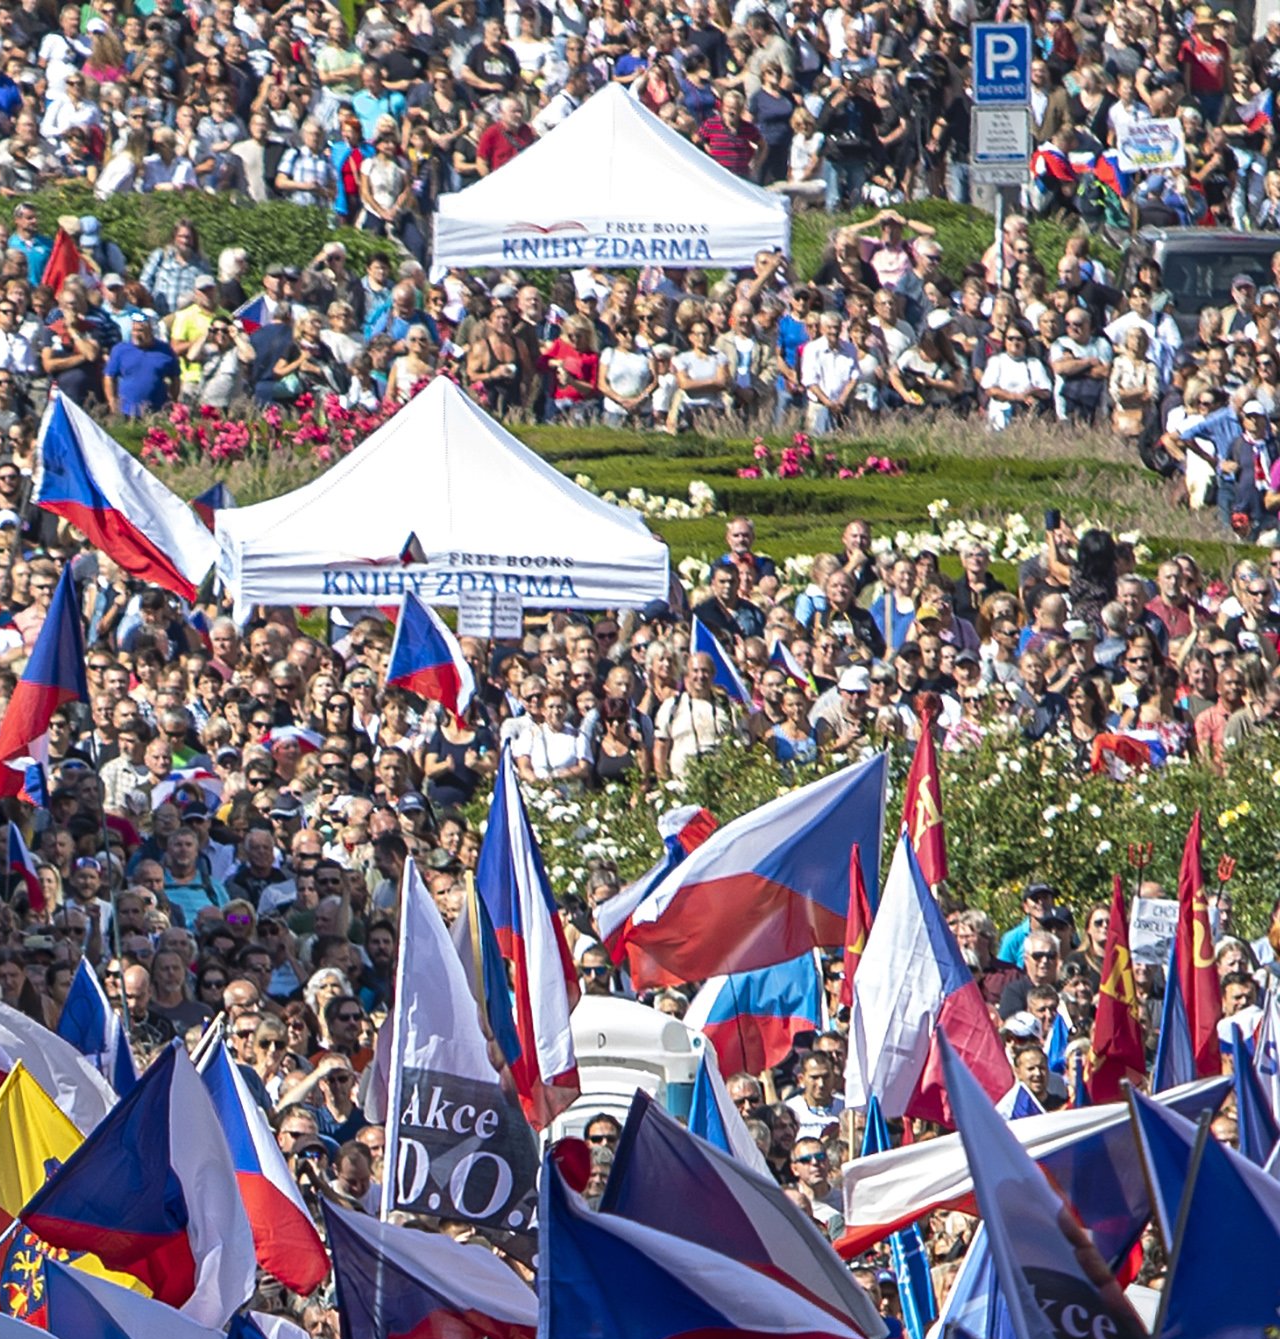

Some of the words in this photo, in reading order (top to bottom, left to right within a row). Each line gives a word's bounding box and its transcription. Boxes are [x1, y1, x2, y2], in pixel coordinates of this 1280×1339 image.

[985, 33, 1019, 80] P
[605, 222, 647, 233] FREE
[653, 222, 710, 234] BOOKS
[502, 238, 589, 259] KNIHY
[593, 238, 714, 260] ZDARMA
[448, 551, 499, 567] FREE
[505, 554, 575, 569] BOOKS
[322, 571, 428, 595] KNIHY
[435, 572, 579, 599] ZDARMA
[400, 1083, 500, 1140] Akce
